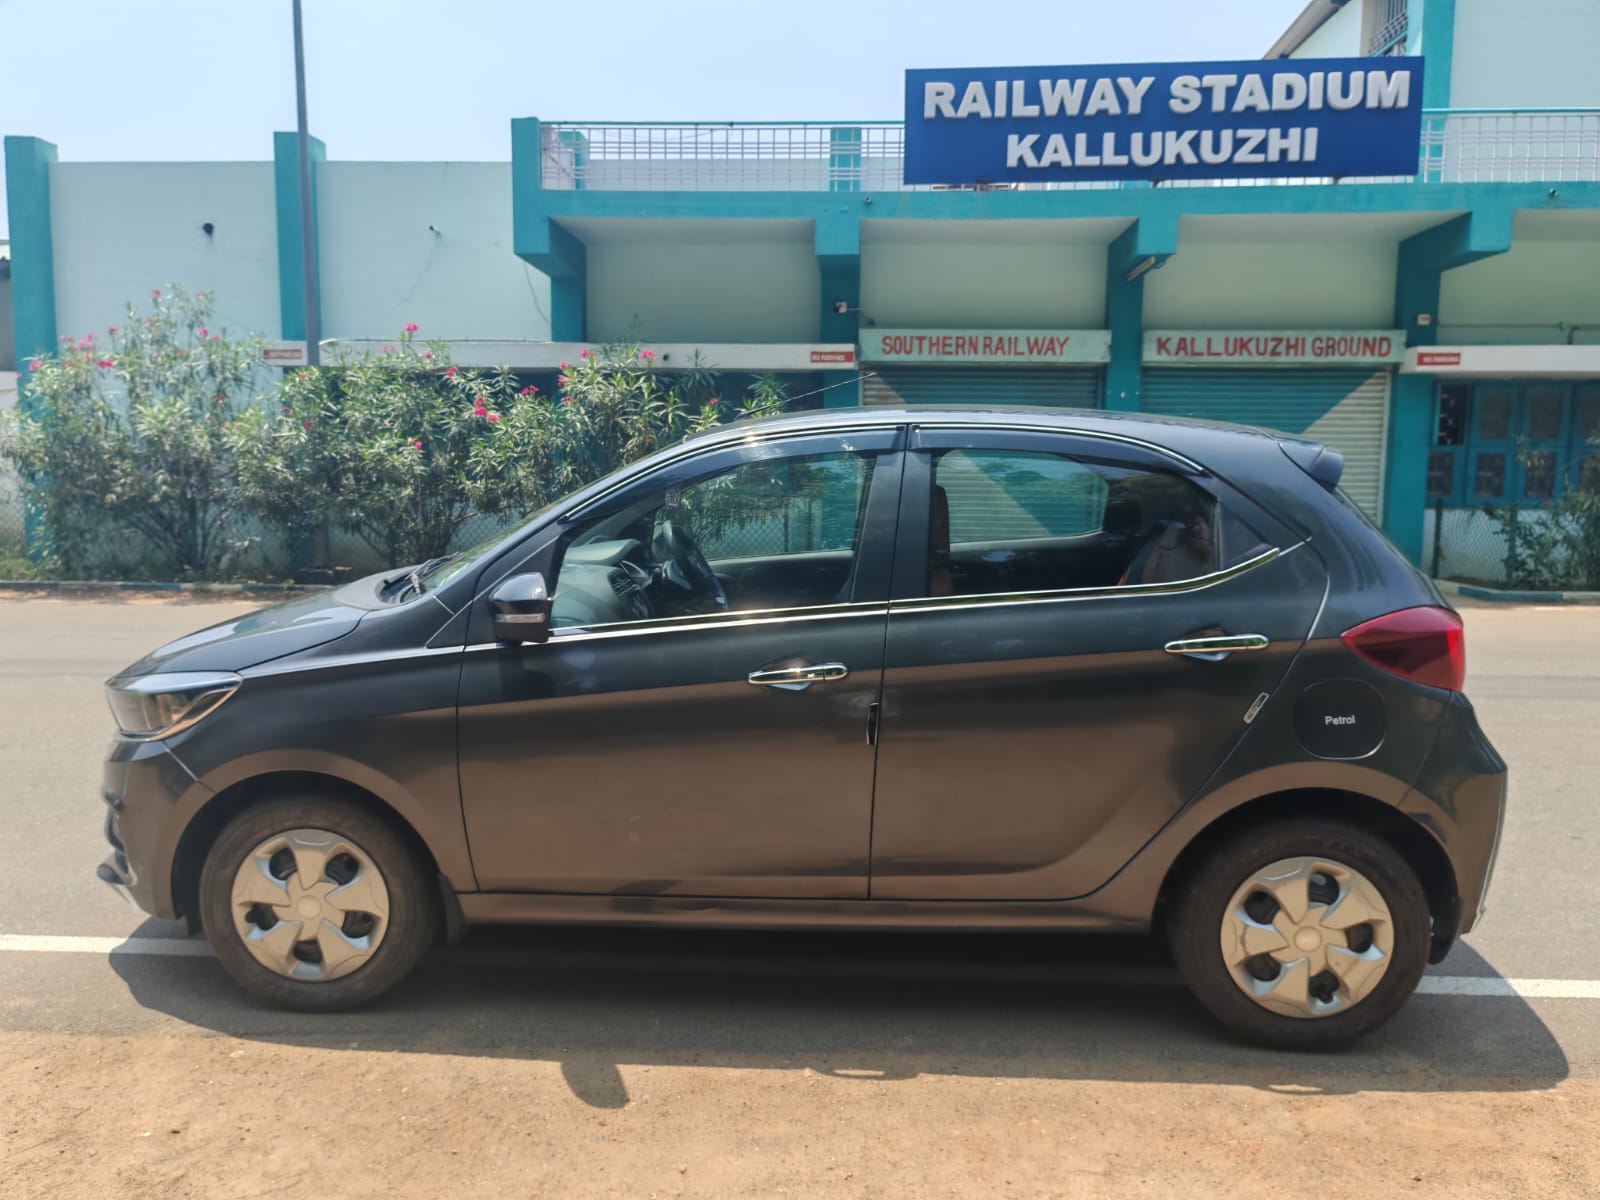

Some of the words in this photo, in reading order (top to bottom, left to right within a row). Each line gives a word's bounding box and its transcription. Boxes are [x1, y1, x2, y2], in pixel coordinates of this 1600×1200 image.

[923, 76, 1155, 119] RAILWAY
[1168, 70, 1411, 113] STADIUM
[1006, 127, 1319, 169] KALLUKUZHI
[881, 335, 979, 356] SOUTHERN
[982, 336, 1070, 357] RAILWAY
[1155, 336, 1306, 357] KALLUKUZHI
[1310, 336, 1392, 358] GROUND
[1324, 714, 1356, 726] Petrol
